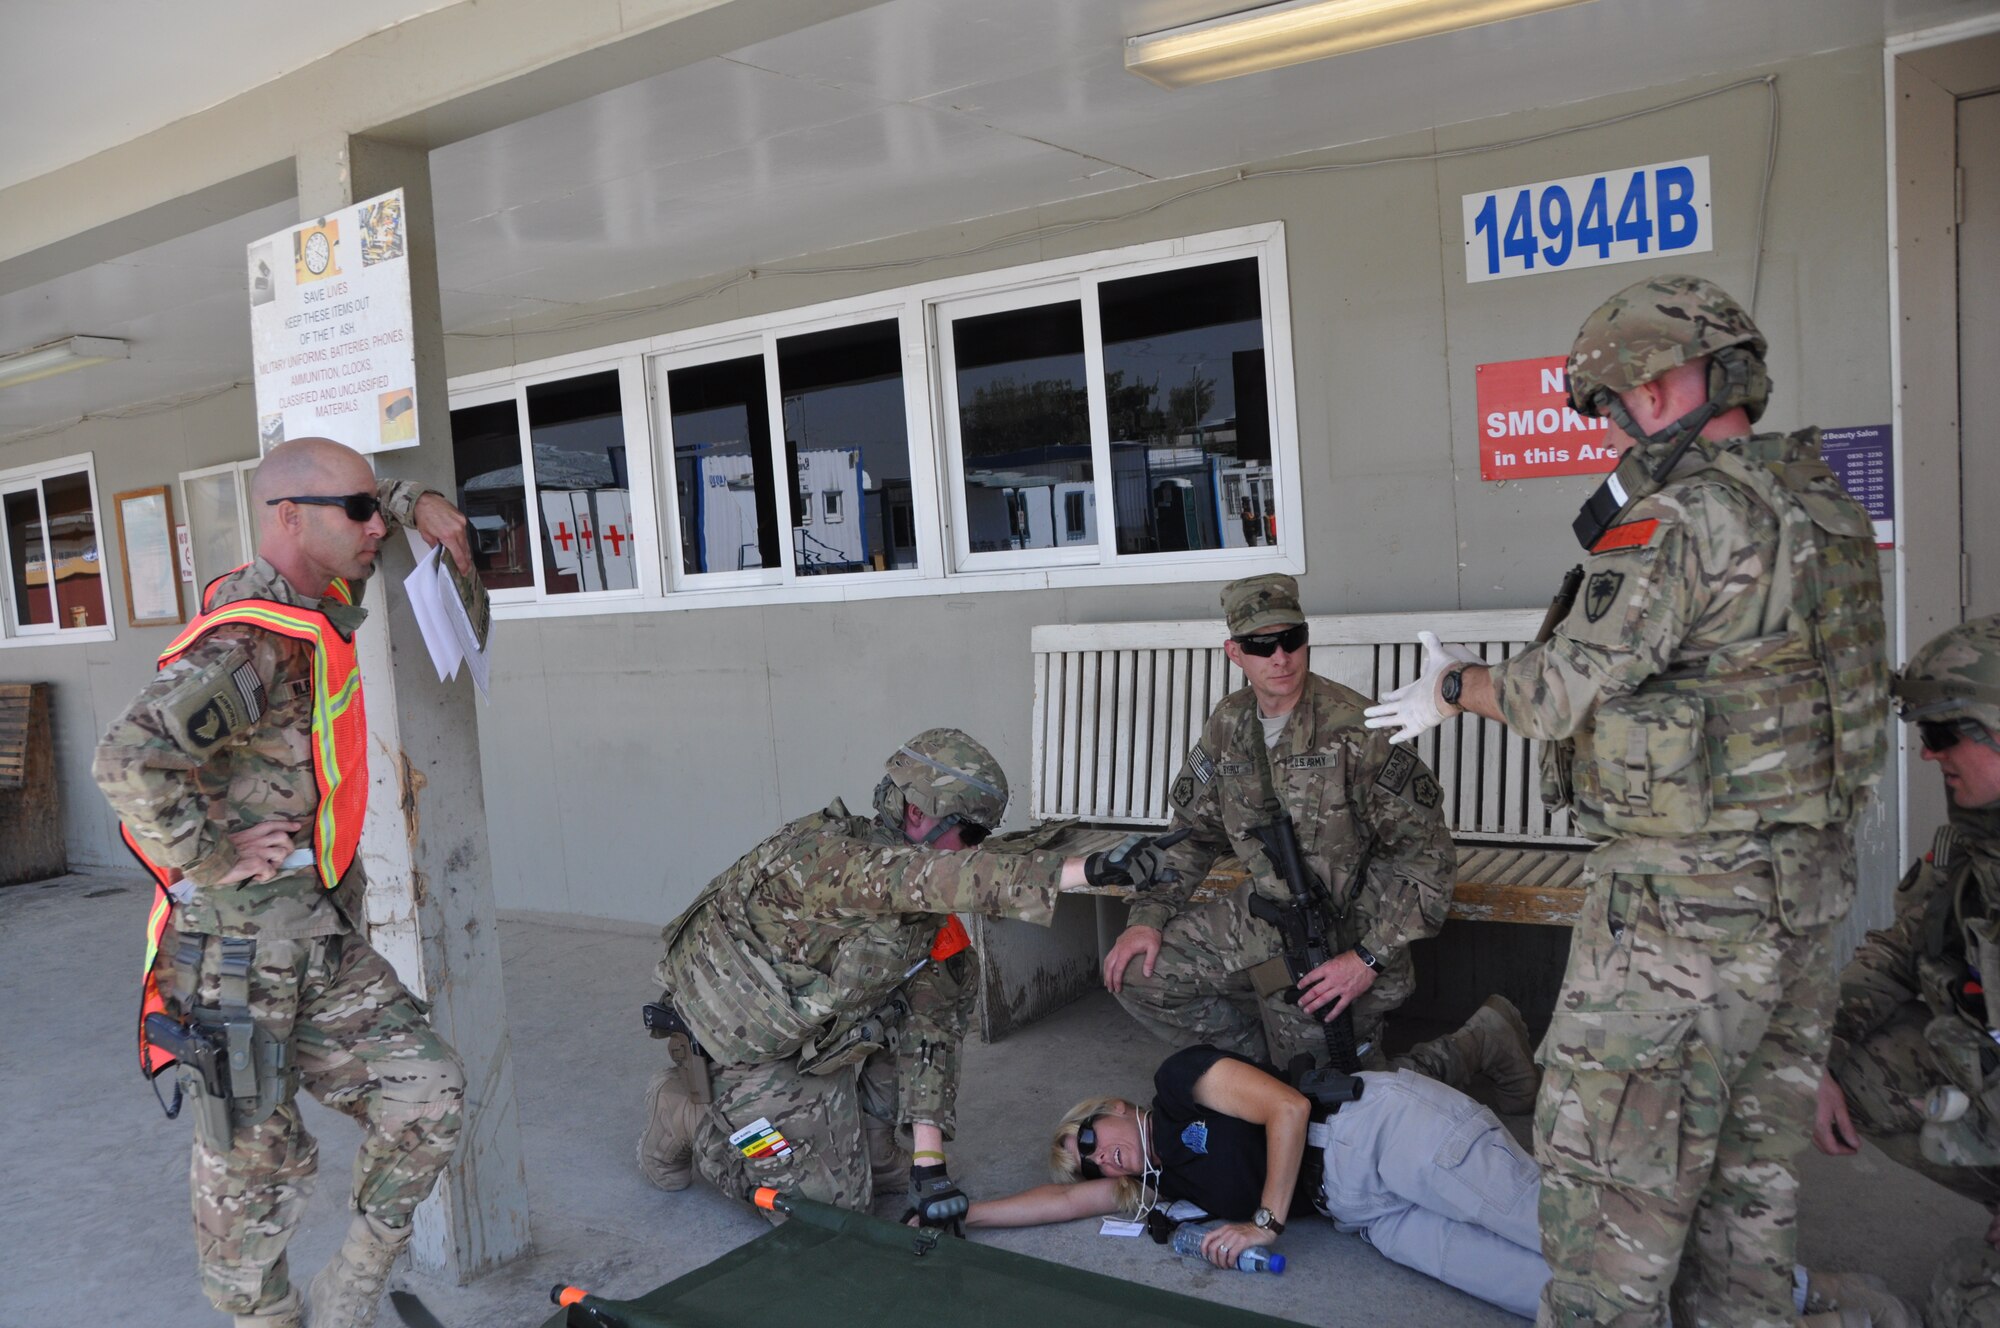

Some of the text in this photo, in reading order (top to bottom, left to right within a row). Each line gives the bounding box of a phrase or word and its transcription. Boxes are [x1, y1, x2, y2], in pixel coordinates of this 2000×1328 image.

[1474, 166, 1698, 274] 14944B
[304, 281, 349, 304] SAVE LIVES
[284, 296, 370, 330] KEEP THESE ITEMS OUT
[300, 332, 312, 346] OF
[313, 328, 328, 343] THE
[258, 358, 287, 376] MILITARY
[1541, 367, 1563, 394] N
[279, 375, 389, 409] CLASSIFIED AND UNCLASSIFIED
[1828, 431, 1855, 440] Beauty
[1856, 430, 1878, 438] Salon
[1495, 444, 1618, 466] in this Are
[1307, 756, 1326, 767] ARMY
